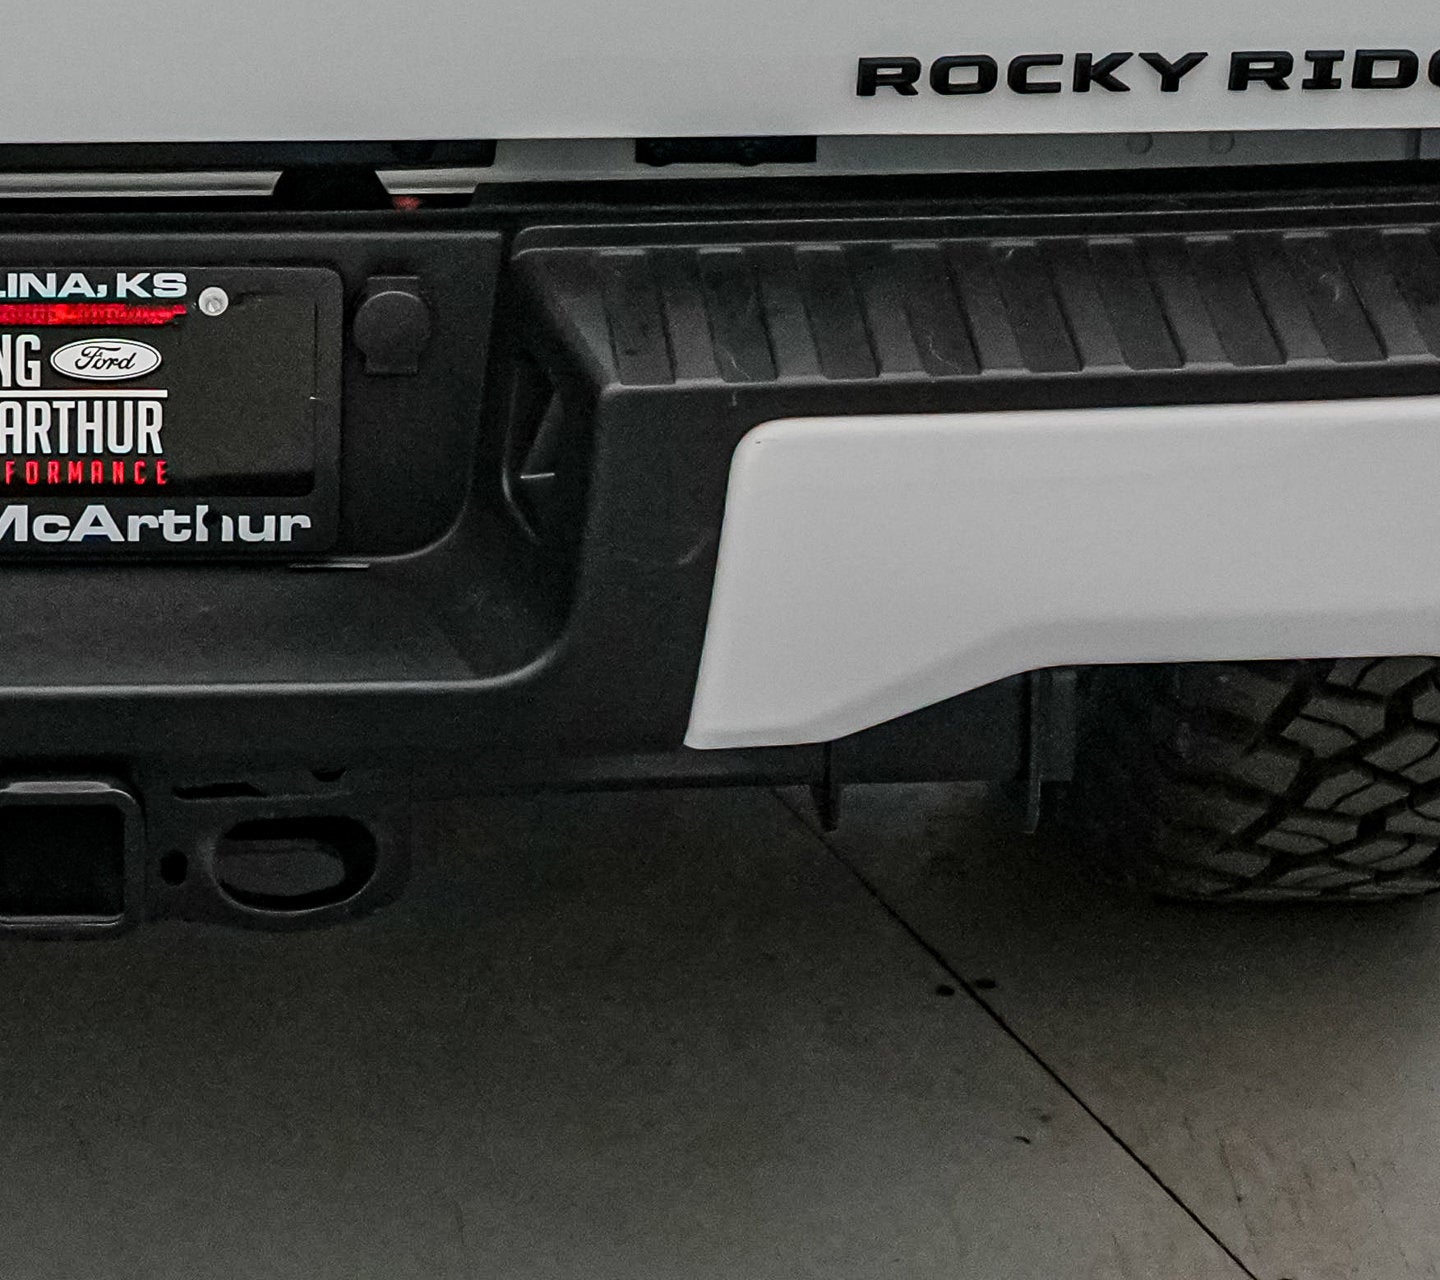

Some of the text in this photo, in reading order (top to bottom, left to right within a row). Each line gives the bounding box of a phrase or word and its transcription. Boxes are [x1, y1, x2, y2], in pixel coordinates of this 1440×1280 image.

[856, 51, 1209, 97] ROCKY
[117, 272, 188, 298] KS
[74, 346, 137, 371] Ford
